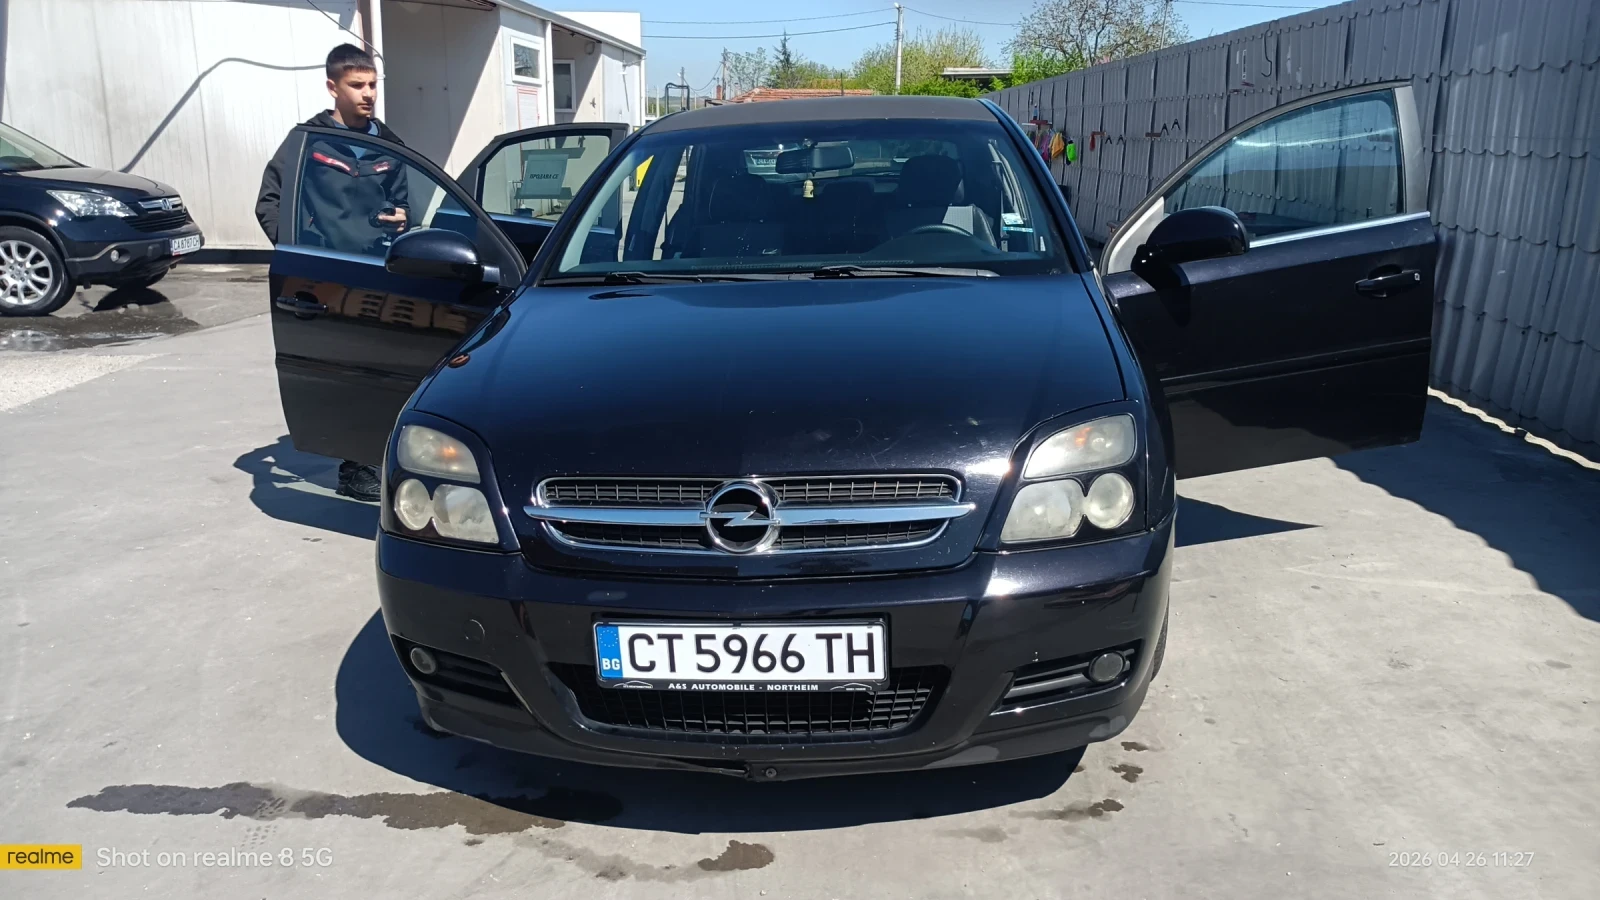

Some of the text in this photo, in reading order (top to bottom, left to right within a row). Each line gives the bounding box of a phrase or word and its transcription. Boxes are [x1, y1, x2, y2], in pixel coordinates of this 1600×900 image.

[628, 632, 876, 674] CT 5966 TH
[603, 658, 620, 670] BG
[691, 683, 755, 691] AUTOMOBILE
